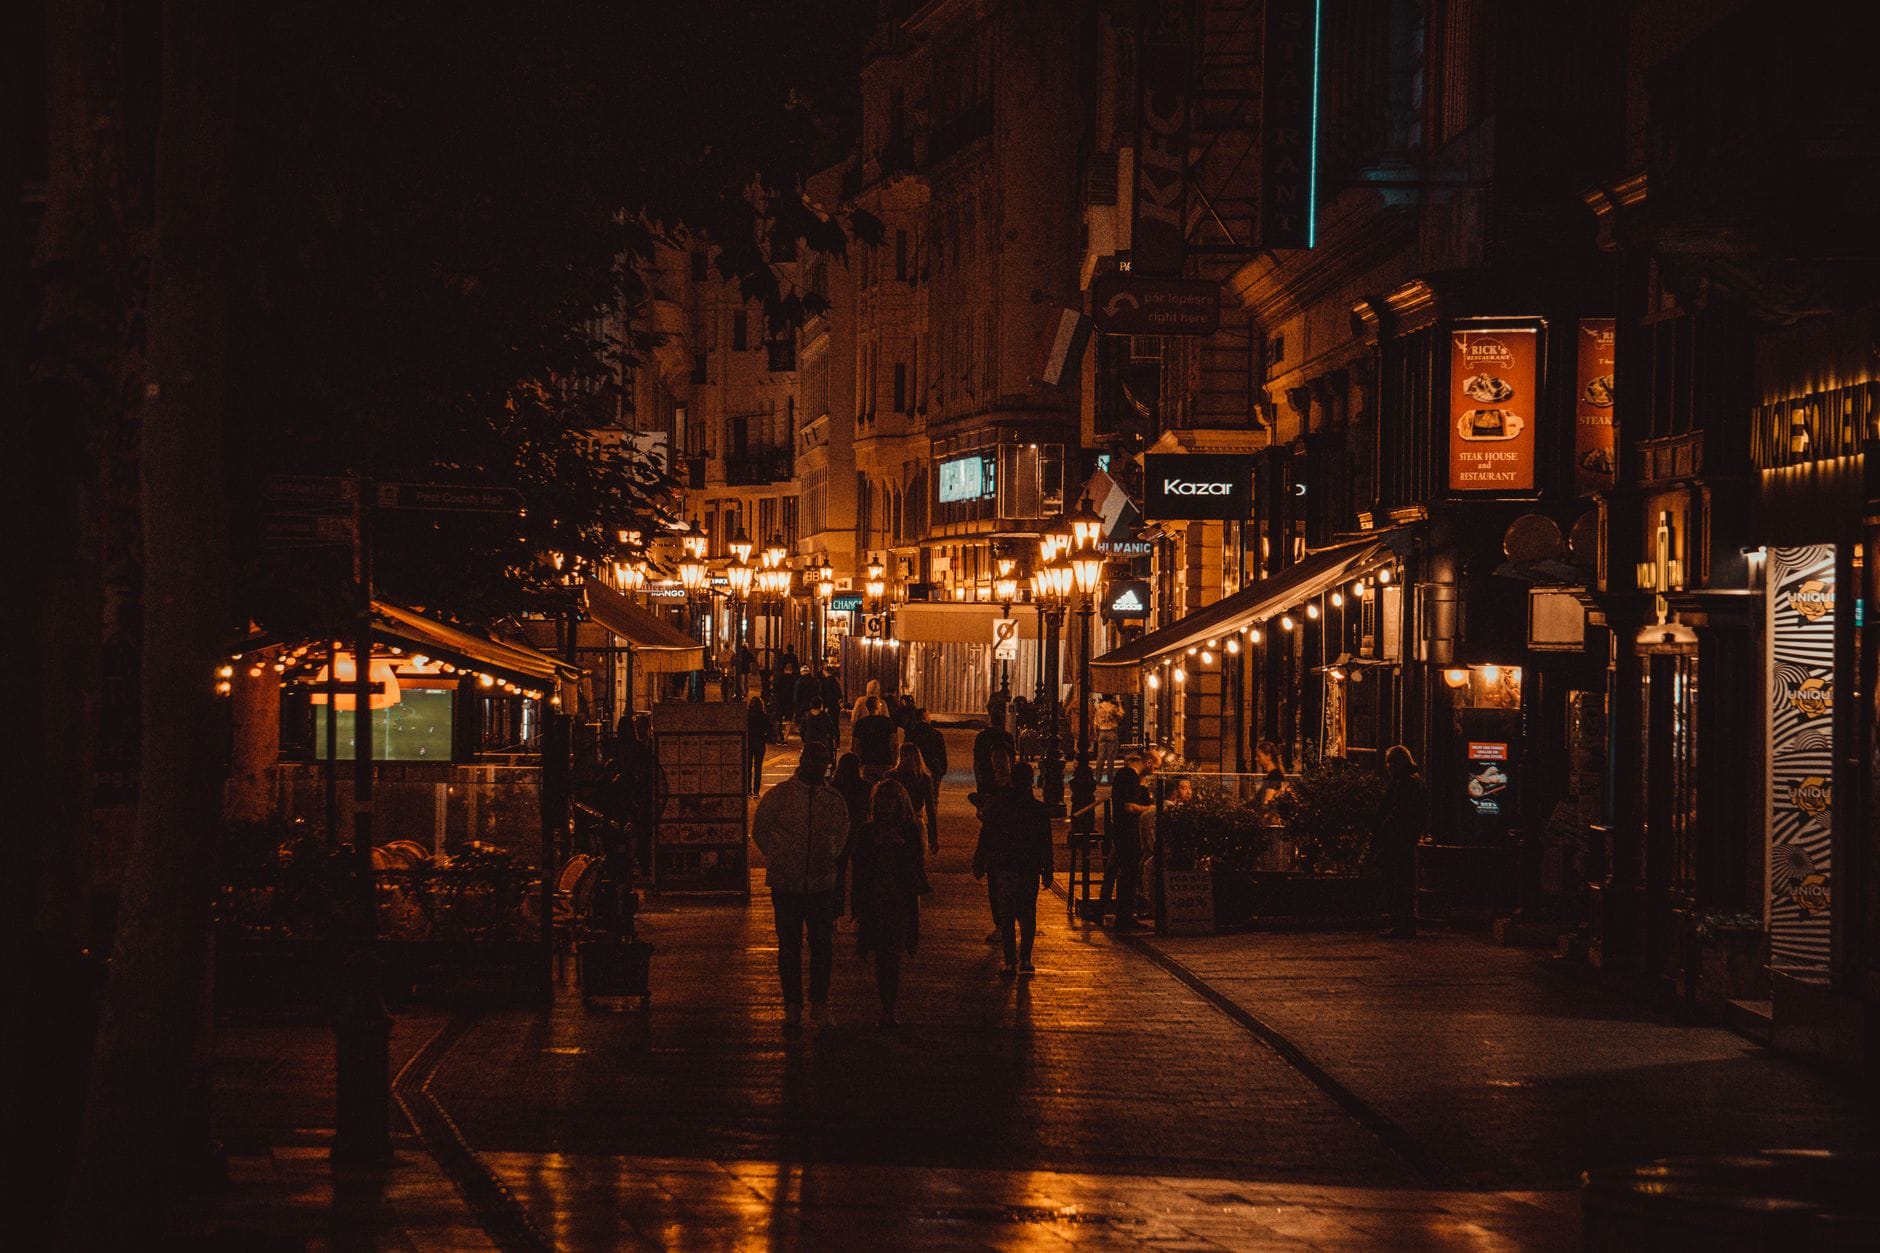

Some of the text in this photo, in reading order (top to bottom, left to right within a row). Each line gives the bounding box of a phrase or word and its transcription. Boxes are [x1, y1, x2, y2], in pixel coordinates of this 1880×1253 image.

[1140, 88, 1186, 225] KFC
[1148, 312, 1209, 325] right here
[1580, 416, 1612, 425] STEAK
[1459, 452, 1518, 461] STEAK HOUSE
[1477, 461, 1492, 469] and
[1459, 472, 1517, 481] RESTAURANT
[1163, 478, 1233, 496] Kazar
